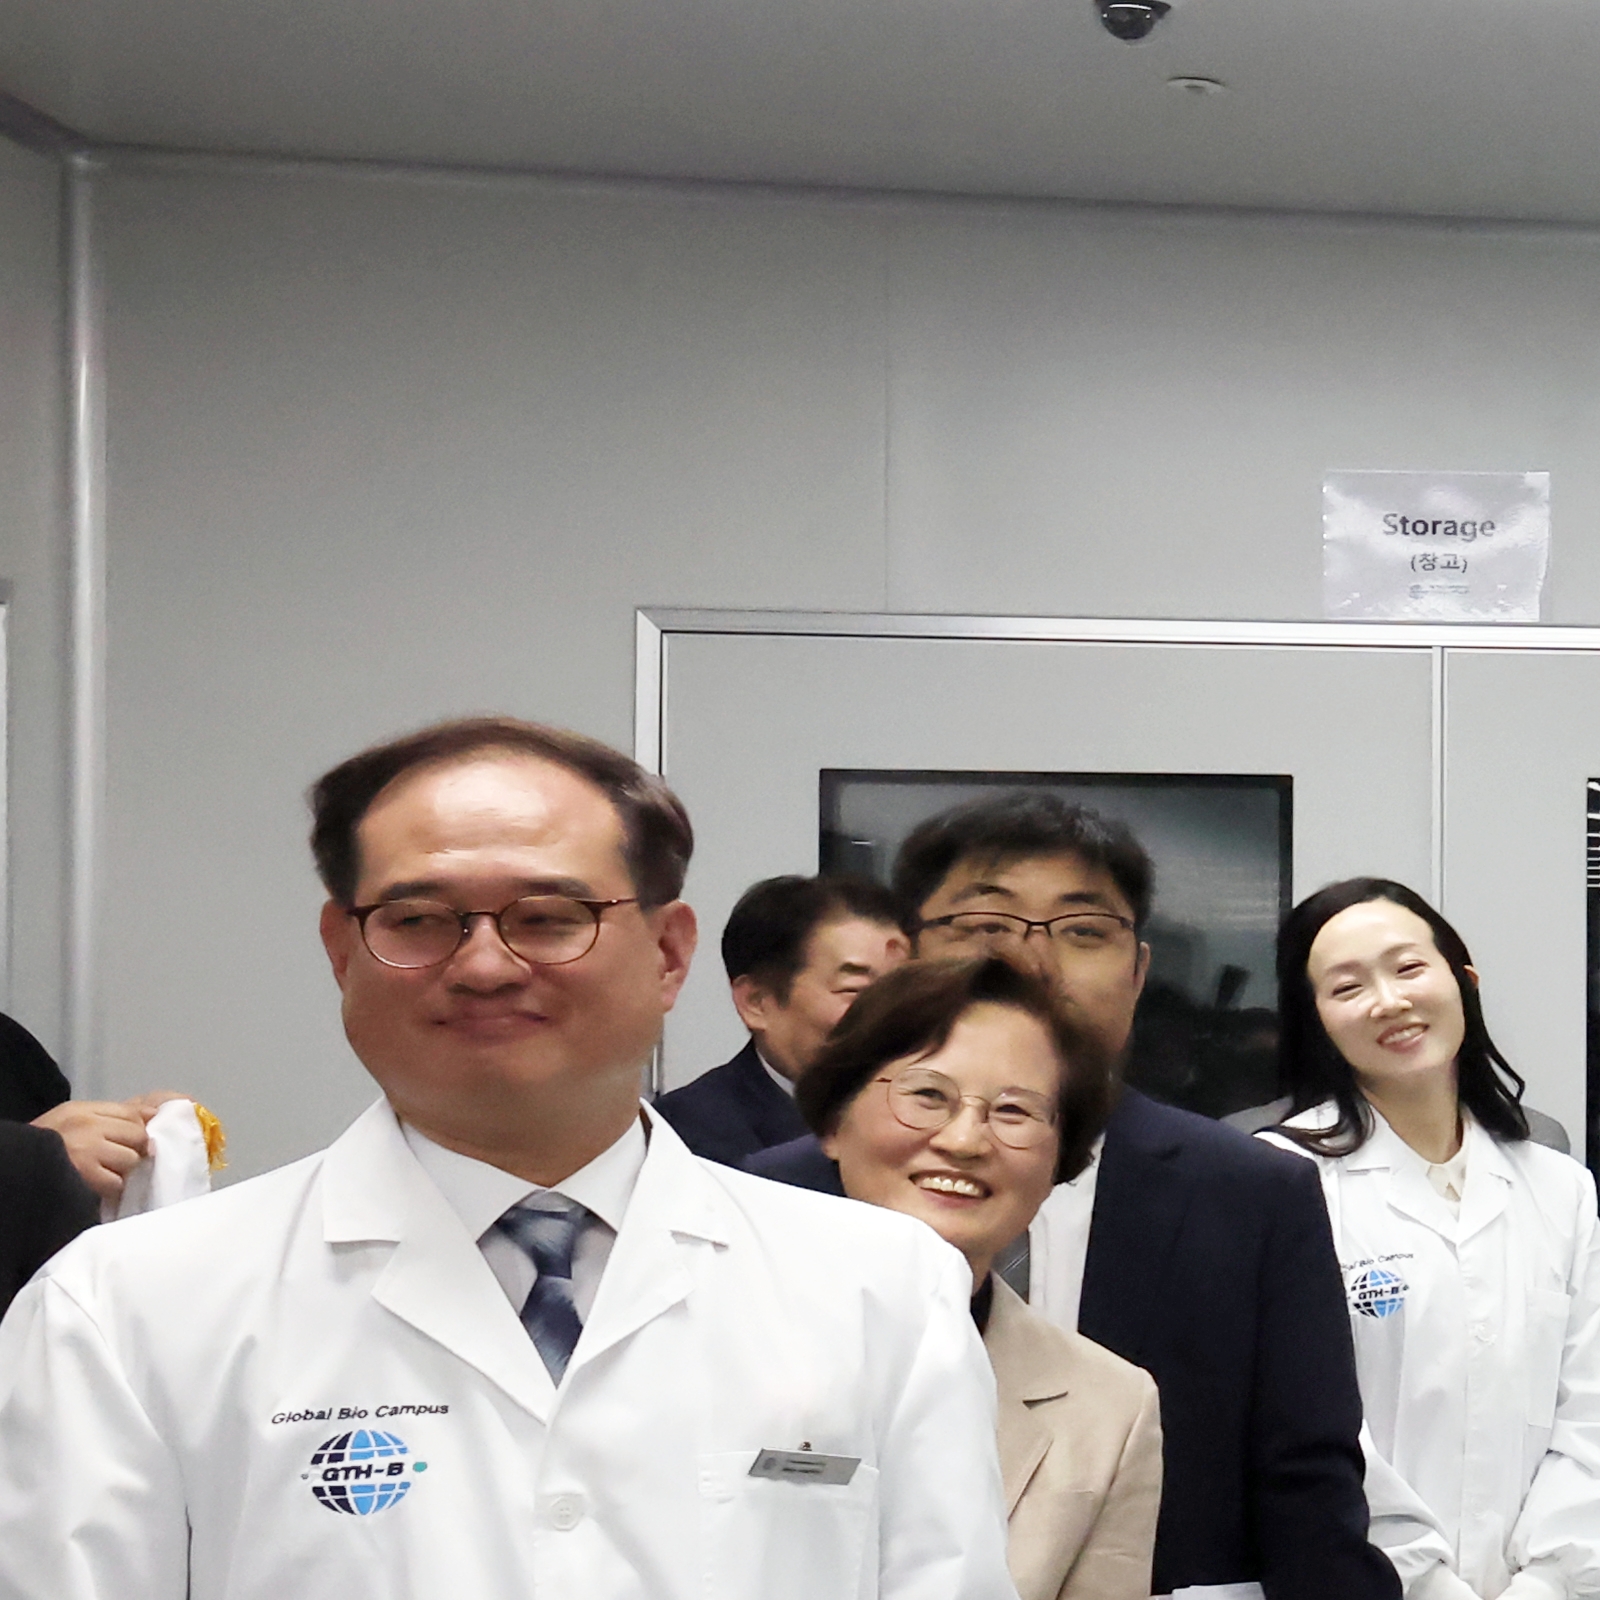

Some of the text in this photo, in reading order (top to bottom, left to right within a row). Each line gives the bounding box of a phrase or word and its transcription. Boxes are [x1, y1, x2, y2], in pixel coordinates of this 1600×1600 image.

[1383, 512, 1496, 542] Storage
[1411, 552, 1468, 573] (창고)
[271, 1403, 450, 1424] Global Bio Campus
[322, 1461, 405, 1482] GTH-B
